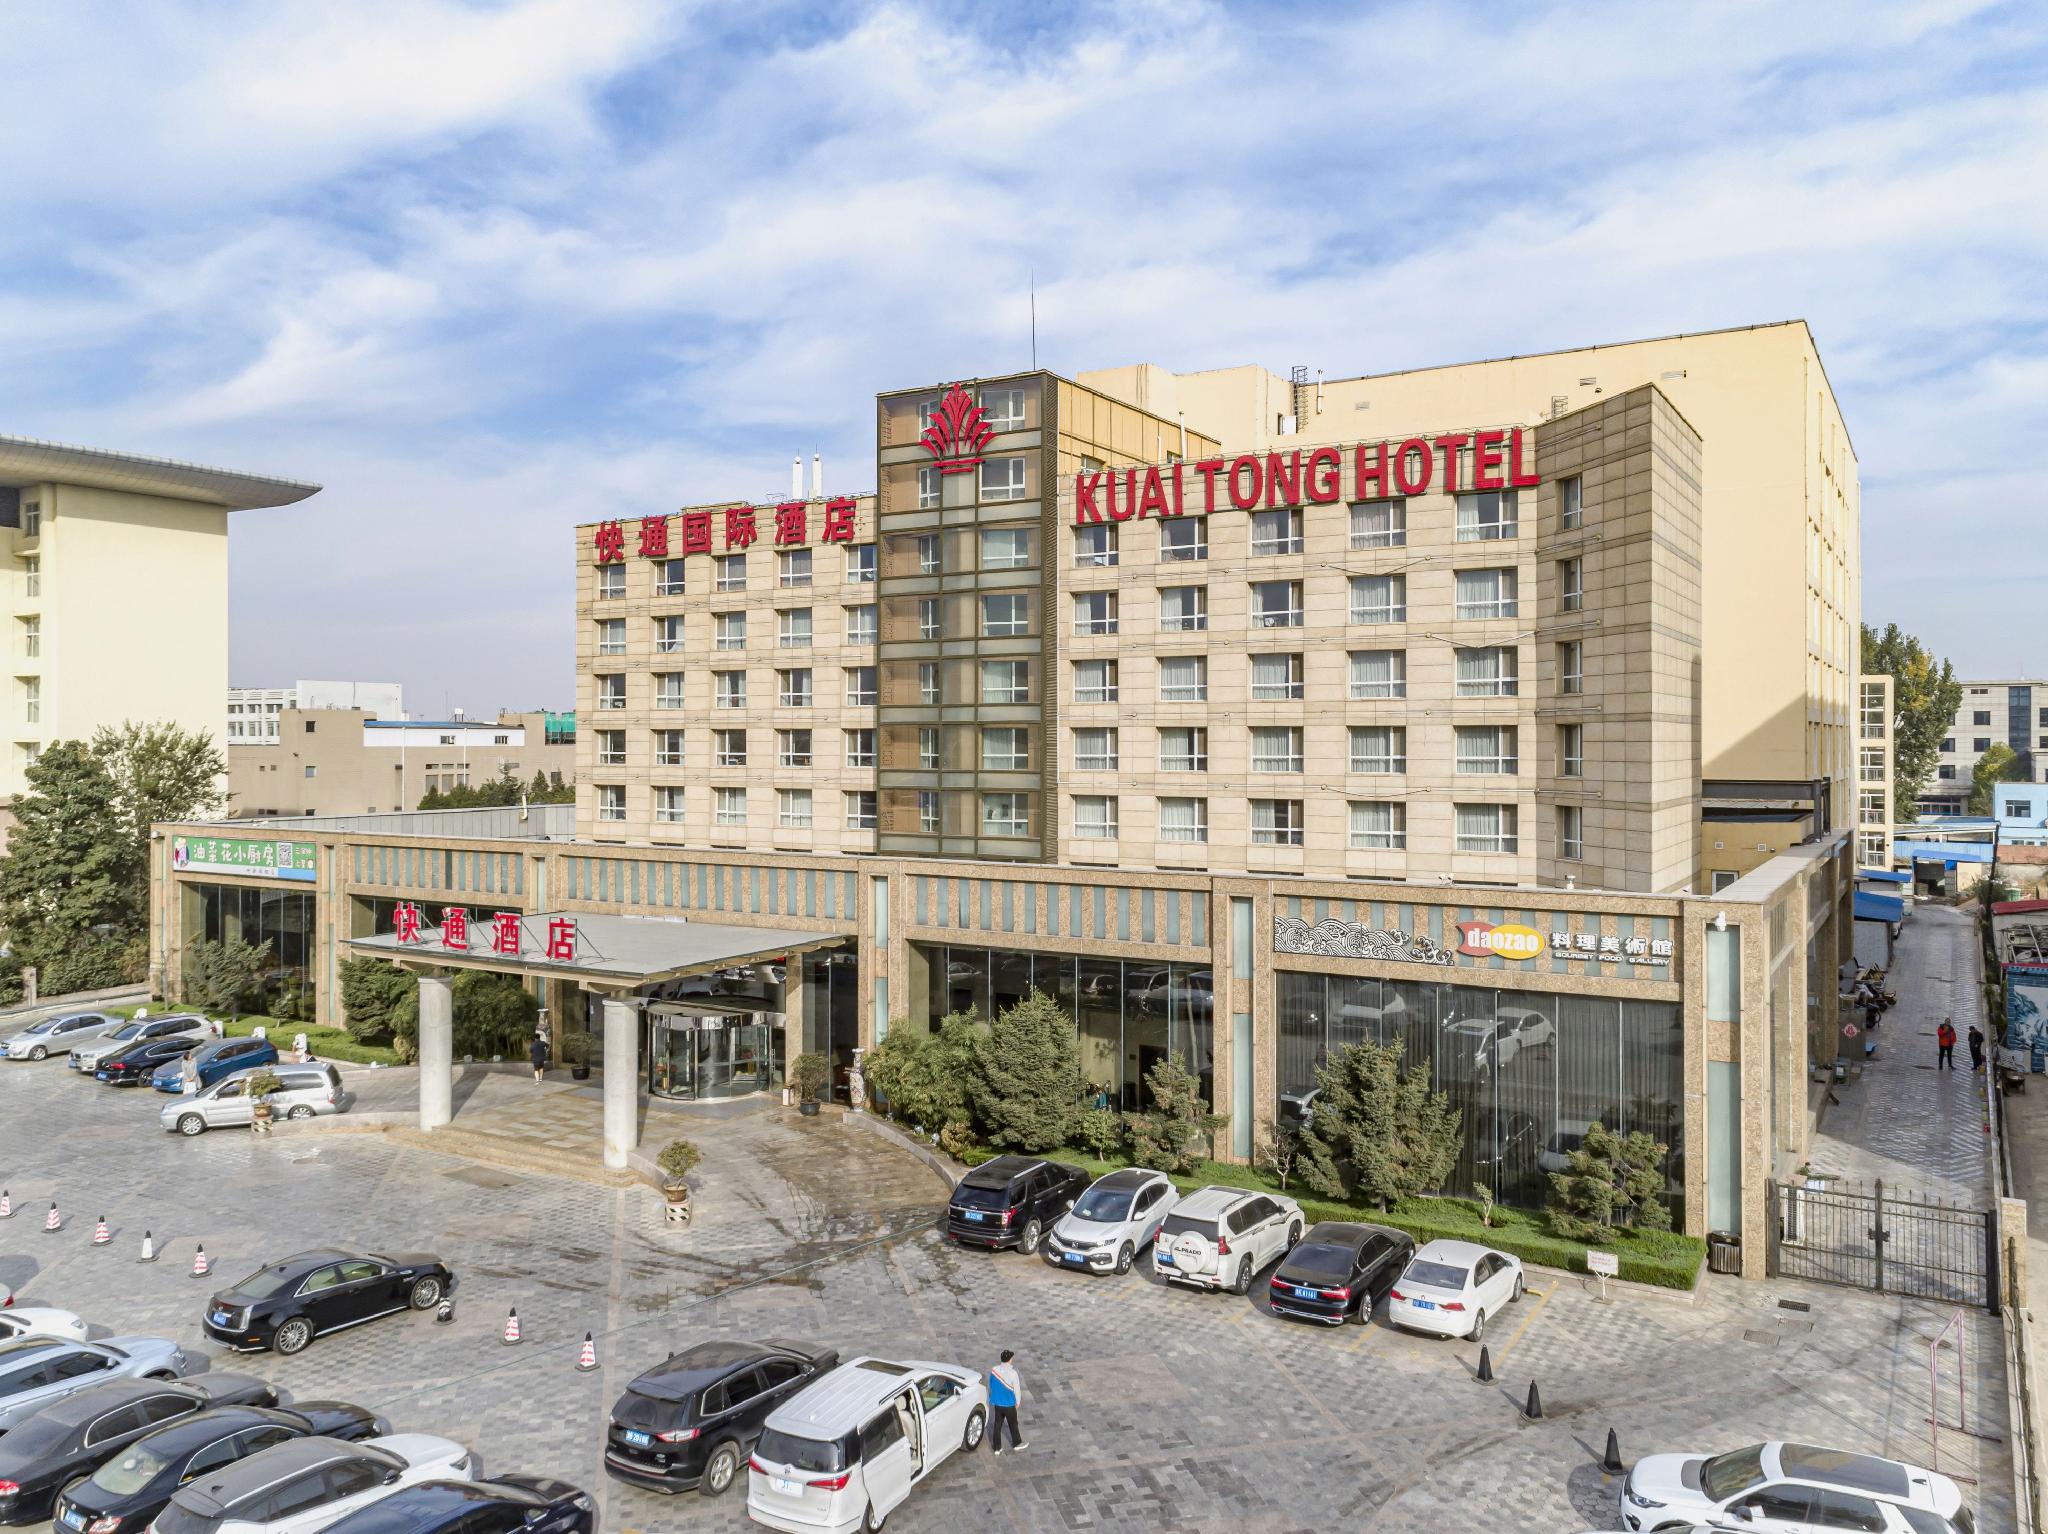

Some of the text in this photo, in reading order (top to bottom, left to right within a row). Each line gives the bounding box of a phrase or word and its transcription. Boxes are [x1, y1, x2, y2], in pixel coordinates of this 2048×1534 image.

[1075, 427, 1540, 525] KUAI TONG HOTEL
[595, 497, 857, 562] 快通国际酒店
[393, 901, 576, 960] 快通酒店
[1467, 928, 1539, 951] daozao
[1551, 932, 1673, 956] 料理美術館
[1555, 952, 1594, 960] GOURMET
[1628, 957, 1670, 966] GALLERY
